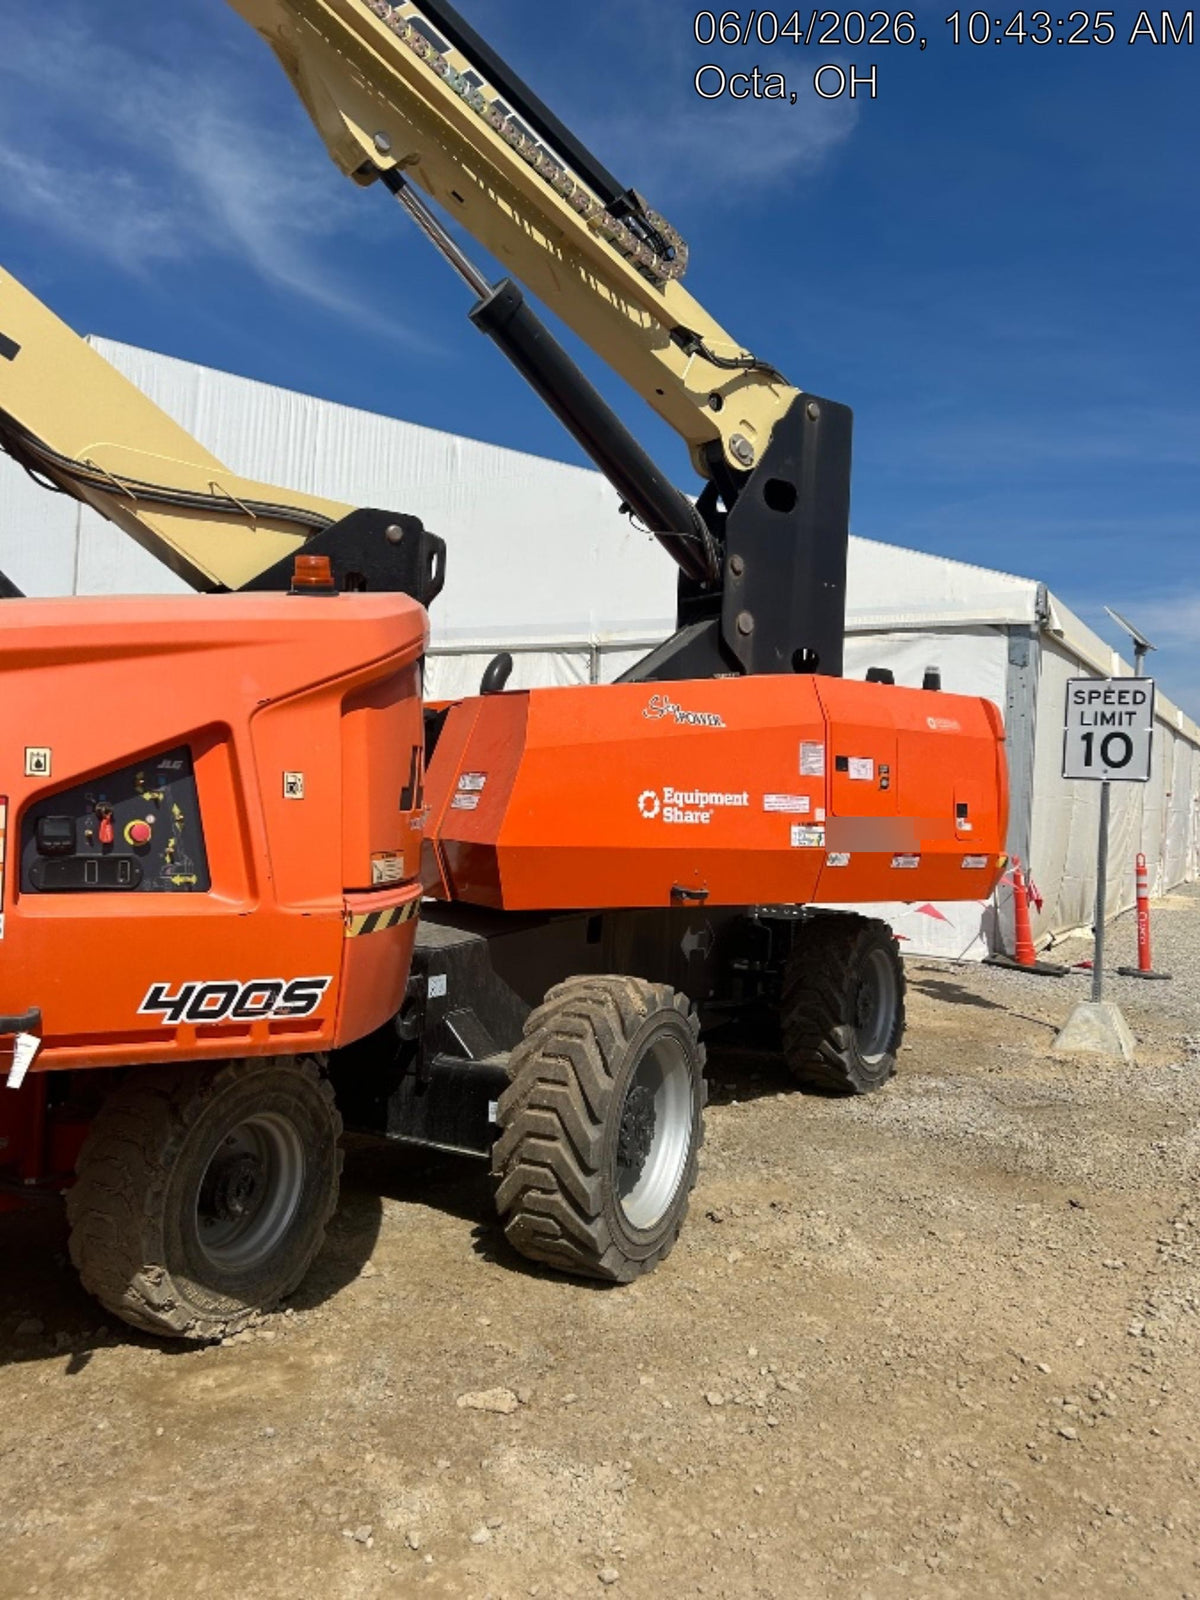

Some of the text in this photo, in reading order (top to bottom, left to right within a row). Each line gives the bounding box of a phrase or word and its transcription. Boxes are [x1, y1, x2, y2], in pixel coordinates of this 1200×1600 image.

[1073, 689, 1147, 705] SPEED
[1080, 710, 1137, 726] LIMIT
[1080, 731, 1134, 769] 10
[662, 786, 749, 807] Equipment
[662, 806, 710, 824] Share
[136, 975, 333, 1025] 400S
